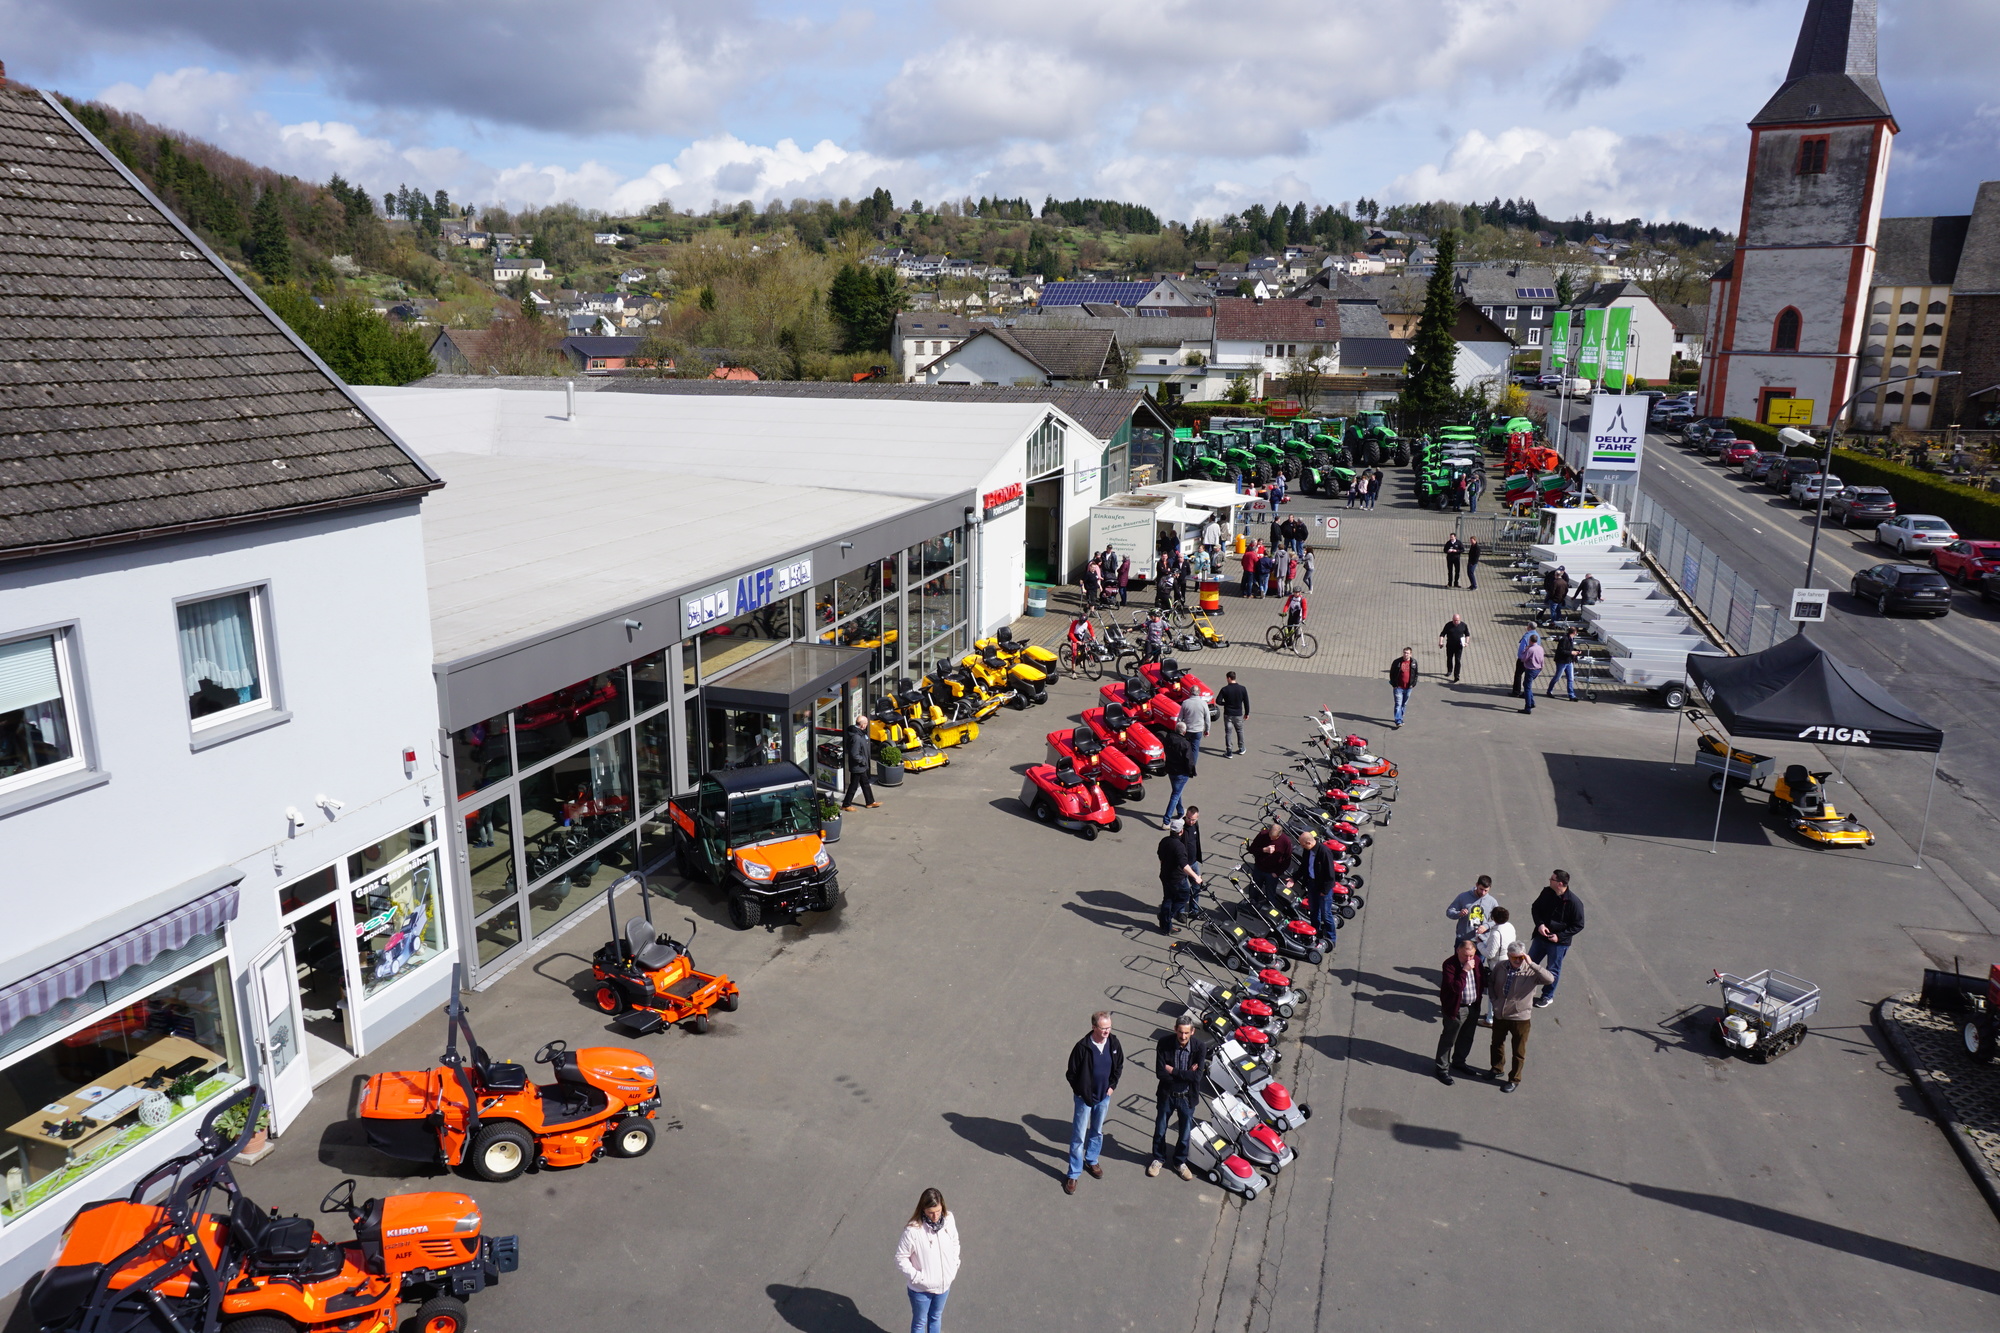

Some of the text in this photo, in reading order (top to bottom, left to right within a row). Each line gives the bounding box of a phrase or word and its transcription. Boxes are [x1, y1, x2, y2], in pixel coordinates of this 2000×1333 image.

[983, 482, 1024, 509] HONDA
[993, 499, 1020, 516] POWER EQUIPMENT
[1123, 518, 1150, 526] Bauernhof
[1558, 517, 1599, 545] LVM
[734, 567, 774, 617] ALFF
[1798, 726, 1870, 744] STIGA
[355, 853, 433, 898] Ganz easy mähen
[363, 924, 390, 942] HONDA
[387, 1225, 429, 1237] KUBOTA
[395, 1251, 412, 1259] ALFF
